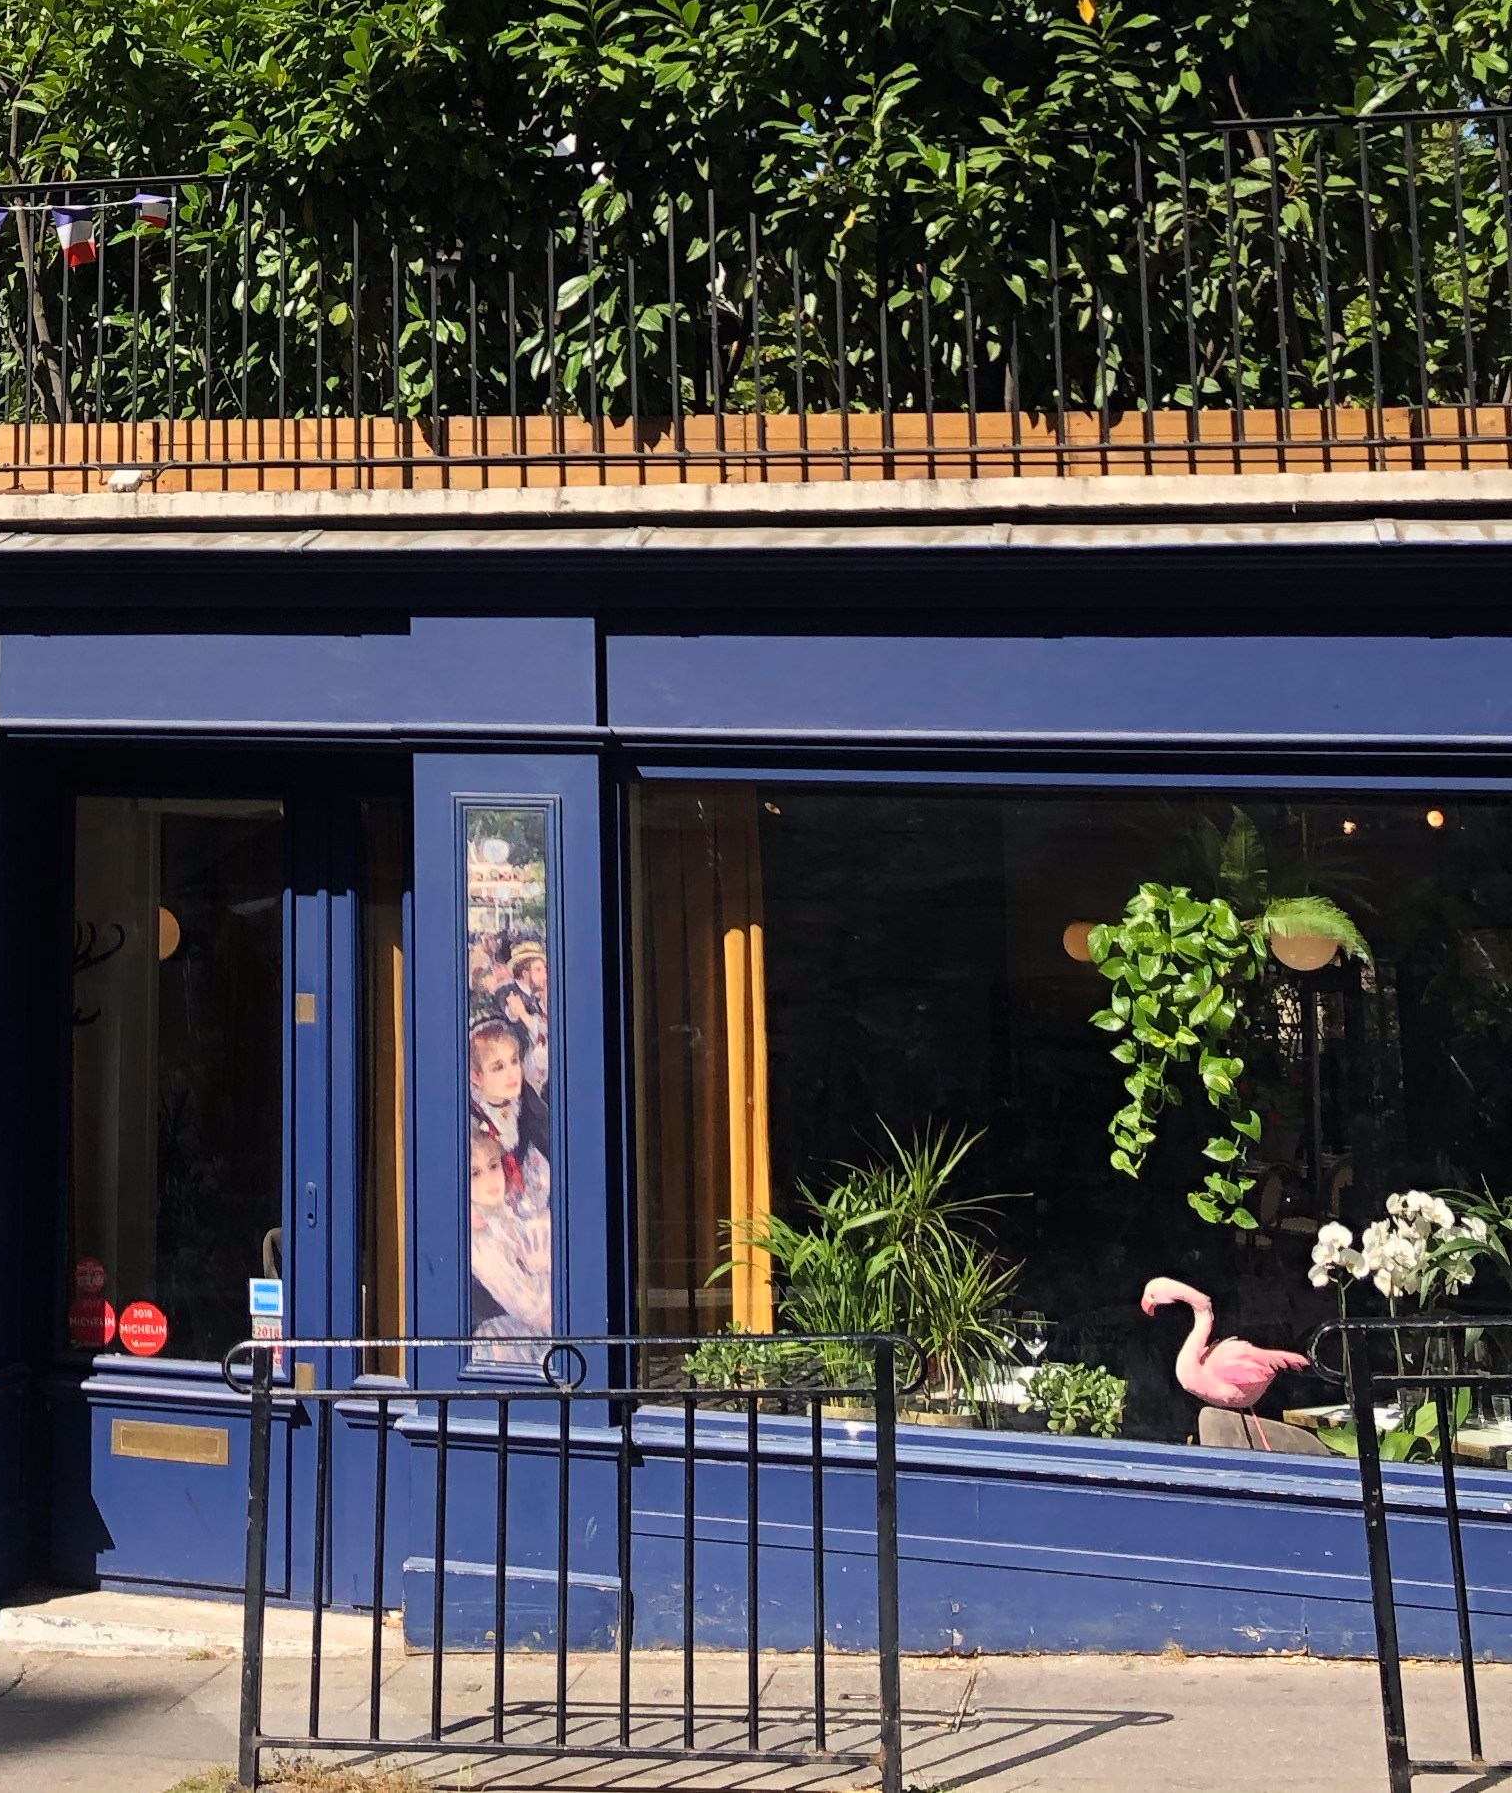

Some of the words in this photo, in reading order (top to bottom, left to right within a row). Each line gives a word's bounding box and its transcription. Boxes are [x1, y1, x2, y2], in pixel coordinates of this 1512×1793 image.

[132, 1309, 153, 1319] 2018
[69, 1317, 115, 1327] MICHELIN
[119, 1323, 167, 1335] MICHELIN
[257, 1326, 280, 1340] 2018
